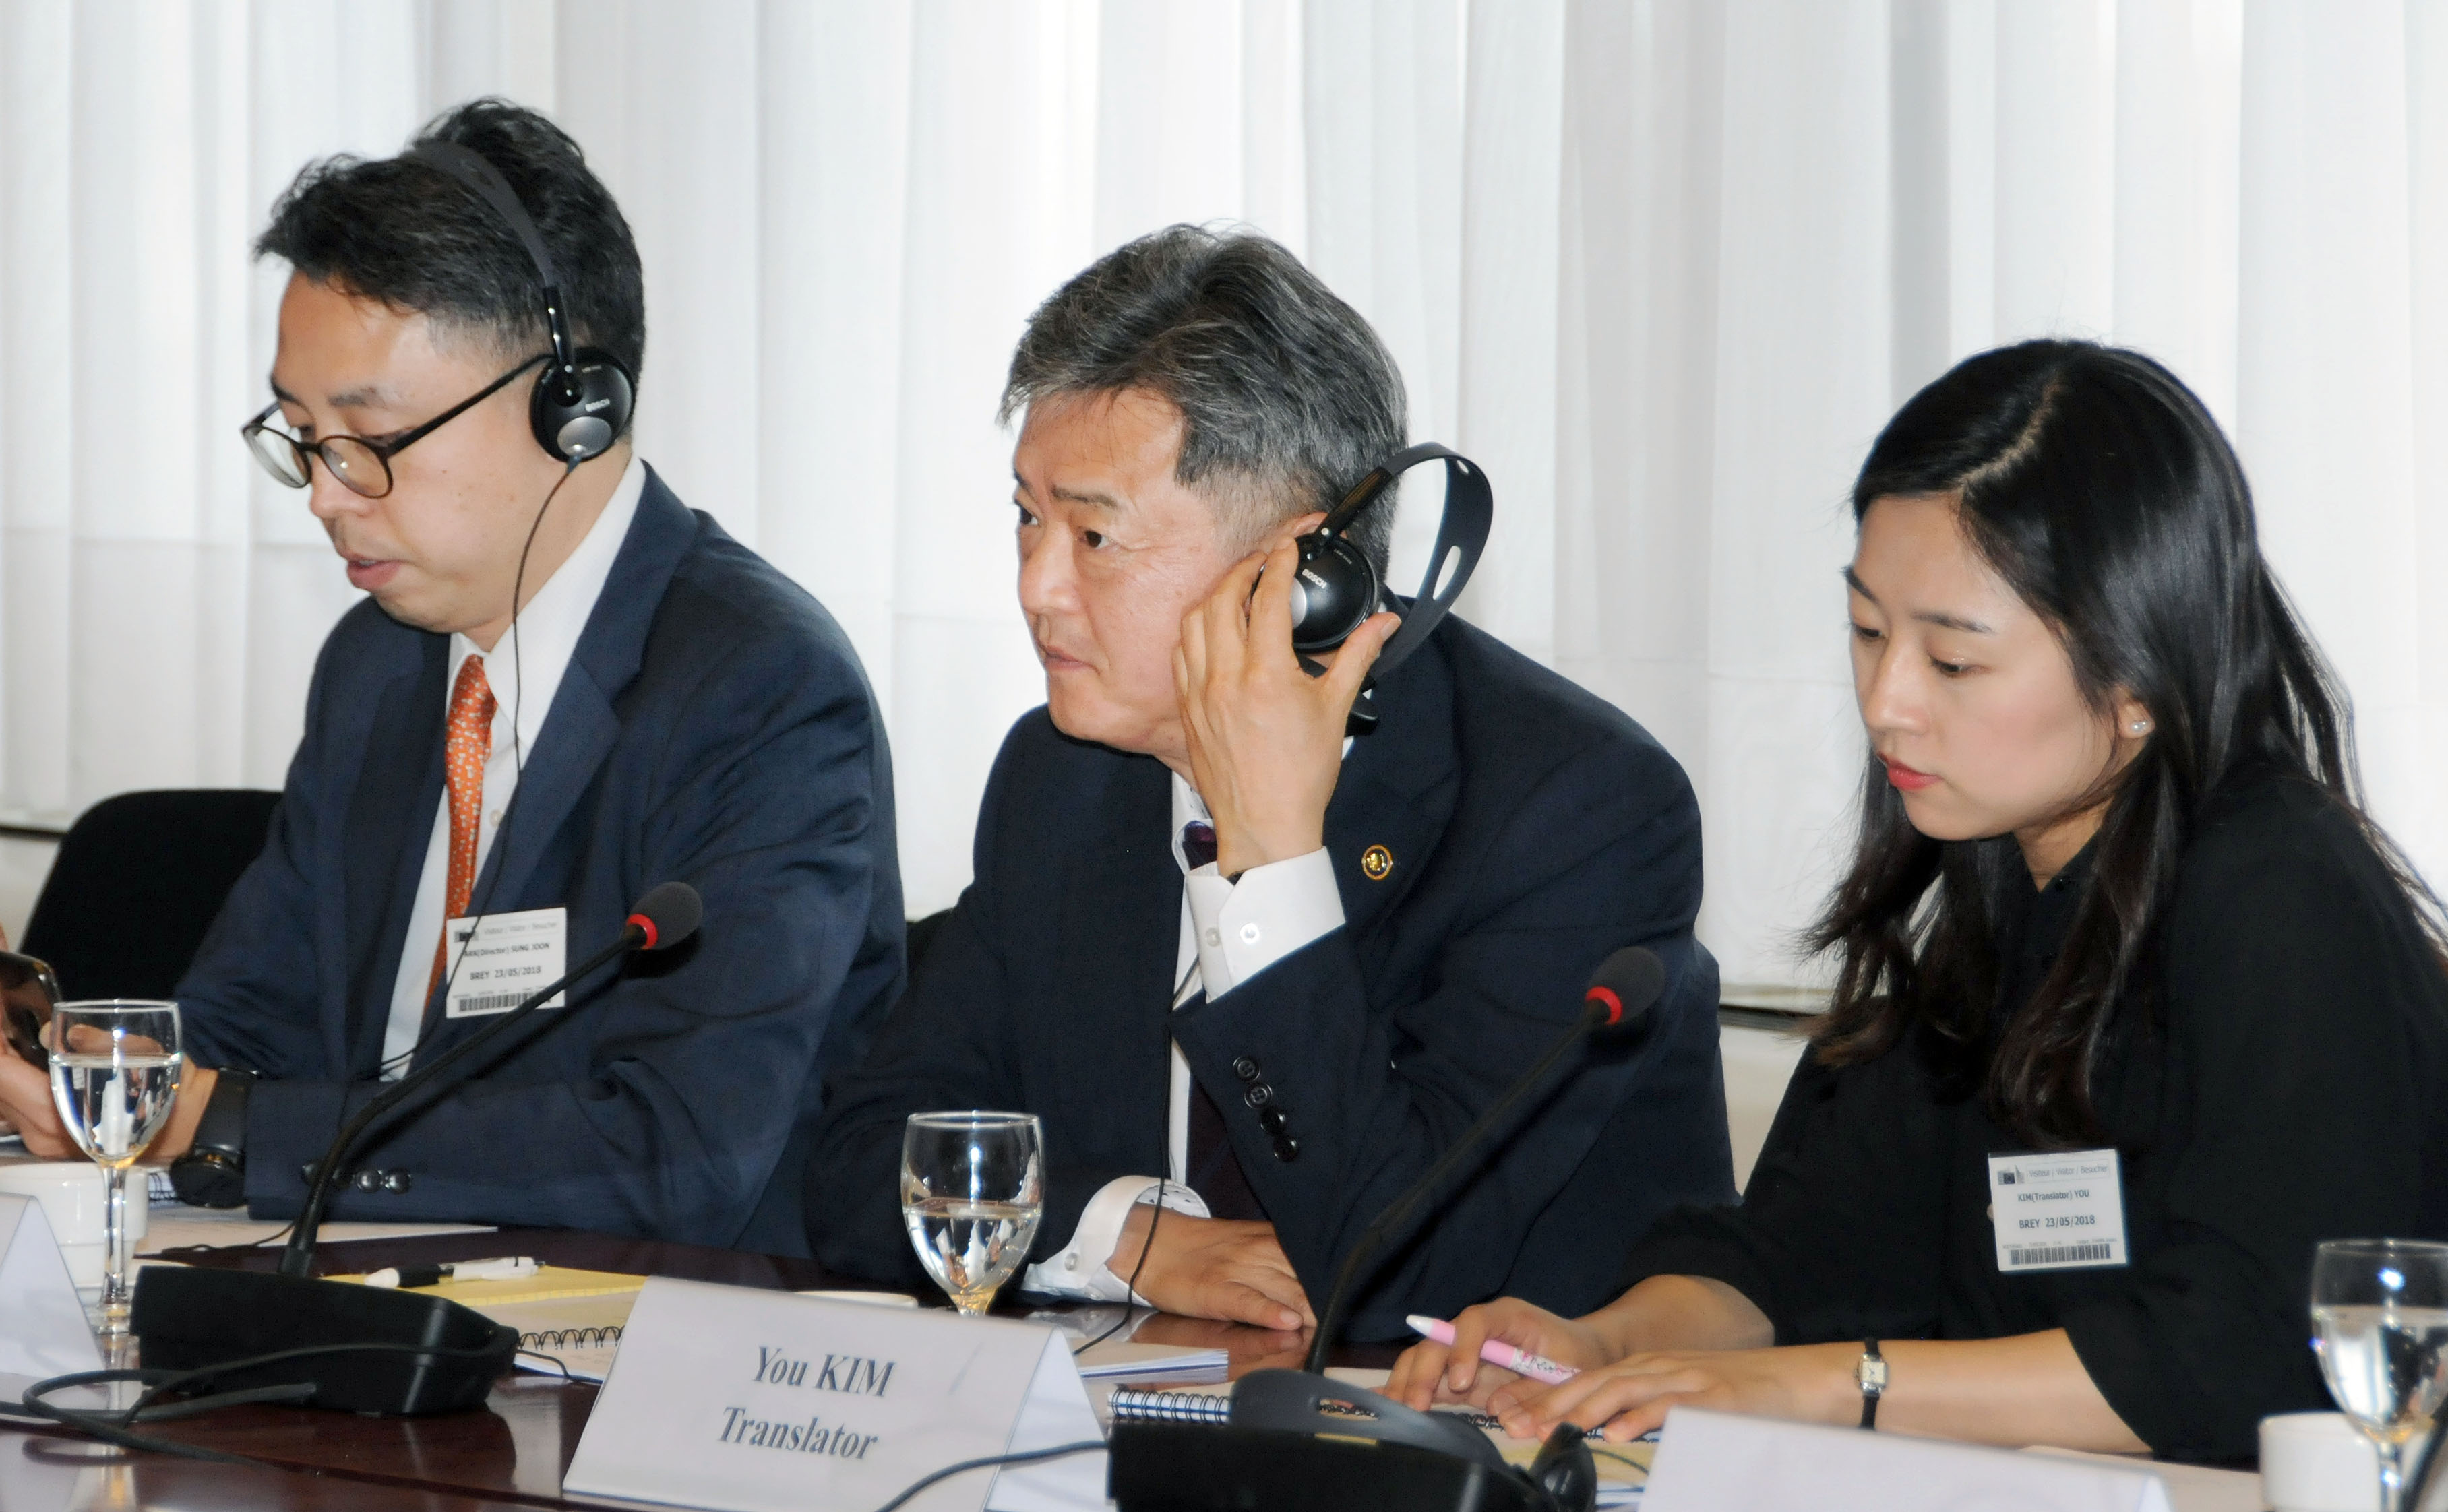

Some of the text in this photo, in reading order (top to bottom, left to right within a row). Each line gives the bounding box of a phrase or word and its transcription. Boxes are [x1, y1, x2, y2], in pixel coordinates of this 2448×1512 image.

[1302, 569, 1327, 589] BOSCH
[470, 966, 541, 980] BREY 23/05/2018
[2017, 1189, 2090, 1202] KIM(Translator) YOU
[2019, 1214, 2095, 1229] BREY 23/05/2018
[752, 1346, 896, 1397] You KIM
[717, 1406, 879, 1459] Translator
